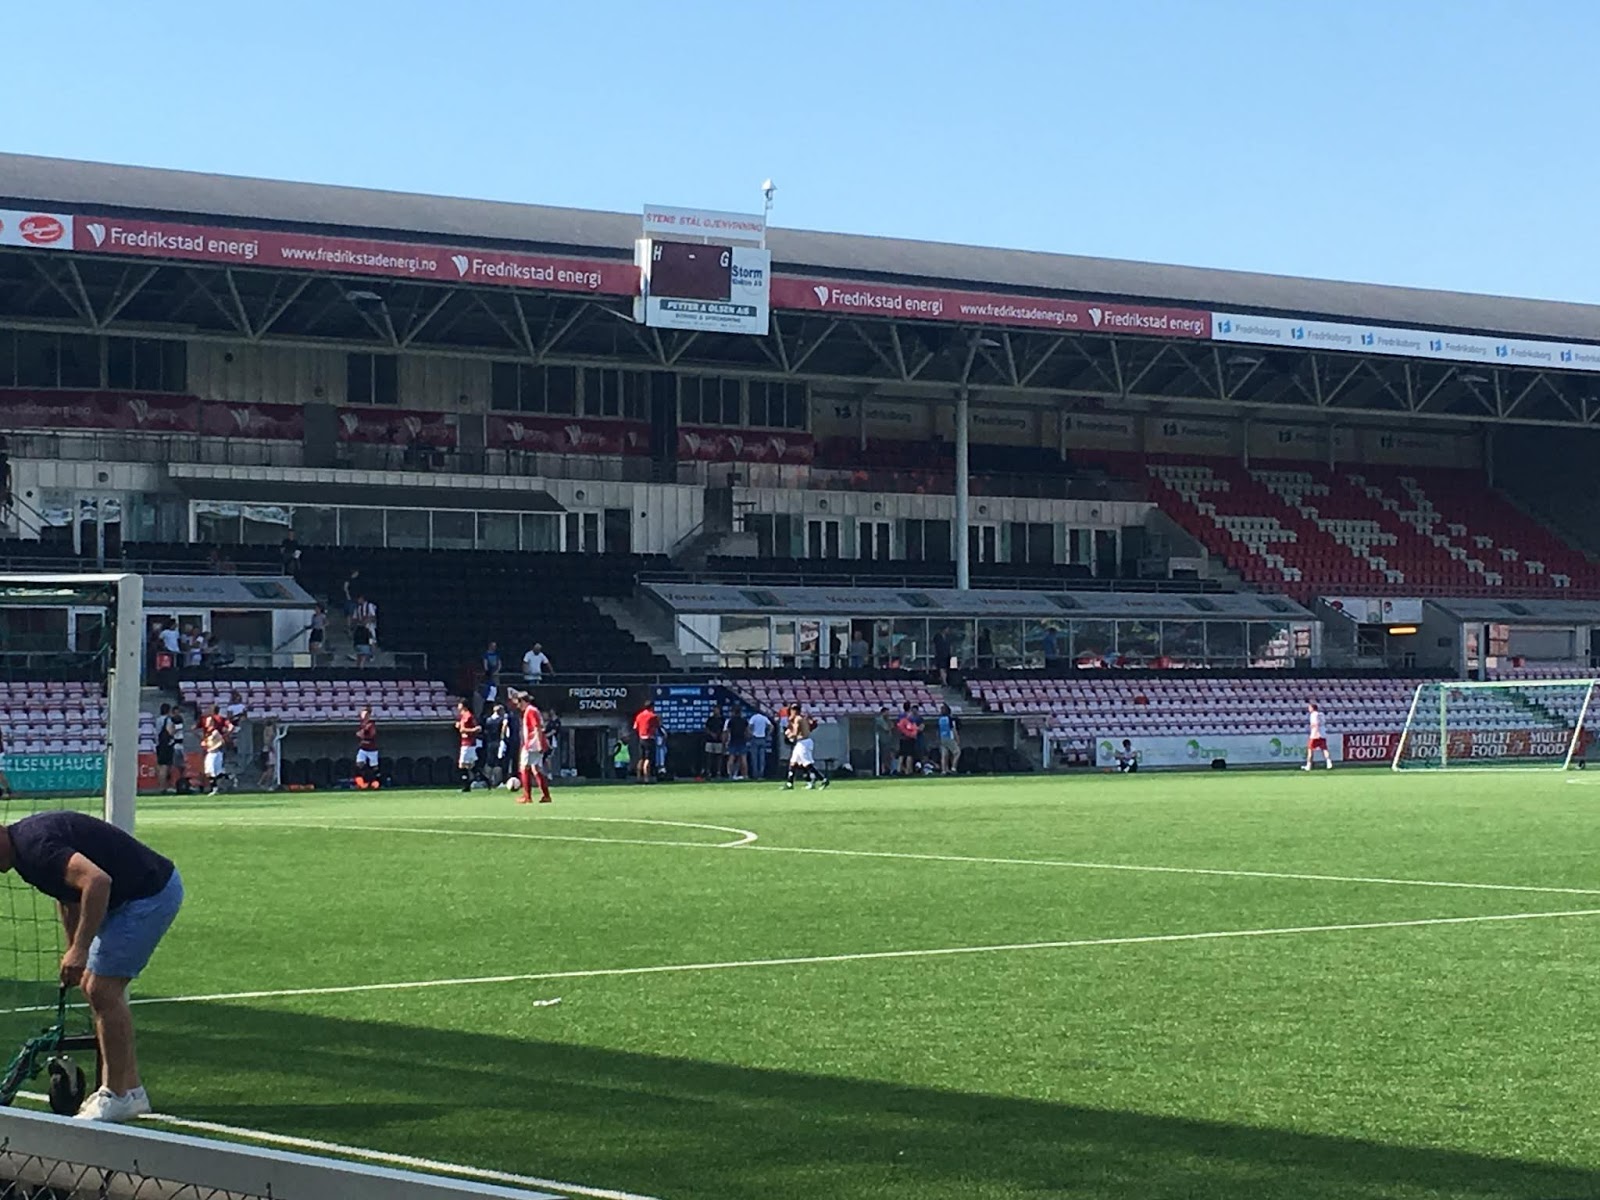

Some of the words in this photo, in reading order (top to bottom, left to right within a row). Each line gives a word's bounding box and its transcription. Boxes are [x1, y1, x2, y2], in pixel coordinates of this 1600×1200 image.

[110, 228, 204, 251] Fredrikstad
[207, 240, 259, 259] energi
[281, 247, 437, 272] www.fredrikstadenergi.no
[653, 245, 662, 261] H
[719, 251, 730, 268] G
[472, 259, 554, 281] Fredrikstad
[557, 270, 602, 288] energi
[732, 264, 762, 279] Storm
[832, 289, 902, 309] Fredrikstad
[905, 299, 943, 315] energi
[708, 304, 735, 315] OLSEN
[960, 304, 1078, 324] www.fredrikstadenergi.no
[1104, 311, 1167, 329] Fredrikstad
[1170, 319, 1204, 335] energi
[568, 687, 627, 698] FREDRIKSTAD
[579, 699, 617, 710] STADION
[1347, 734, 1391, 746] MULTI
[1471, 732, 1511, 745] MULTI
[1530, 731, 1569, 743] MULTI
[1347, 747, 1387, 759] FOOD
[1411, 746, 1441, 759] FOO
[1470, 745, 1508, 757] FOOD
[1530, 743, 1566, 755] FOOD
